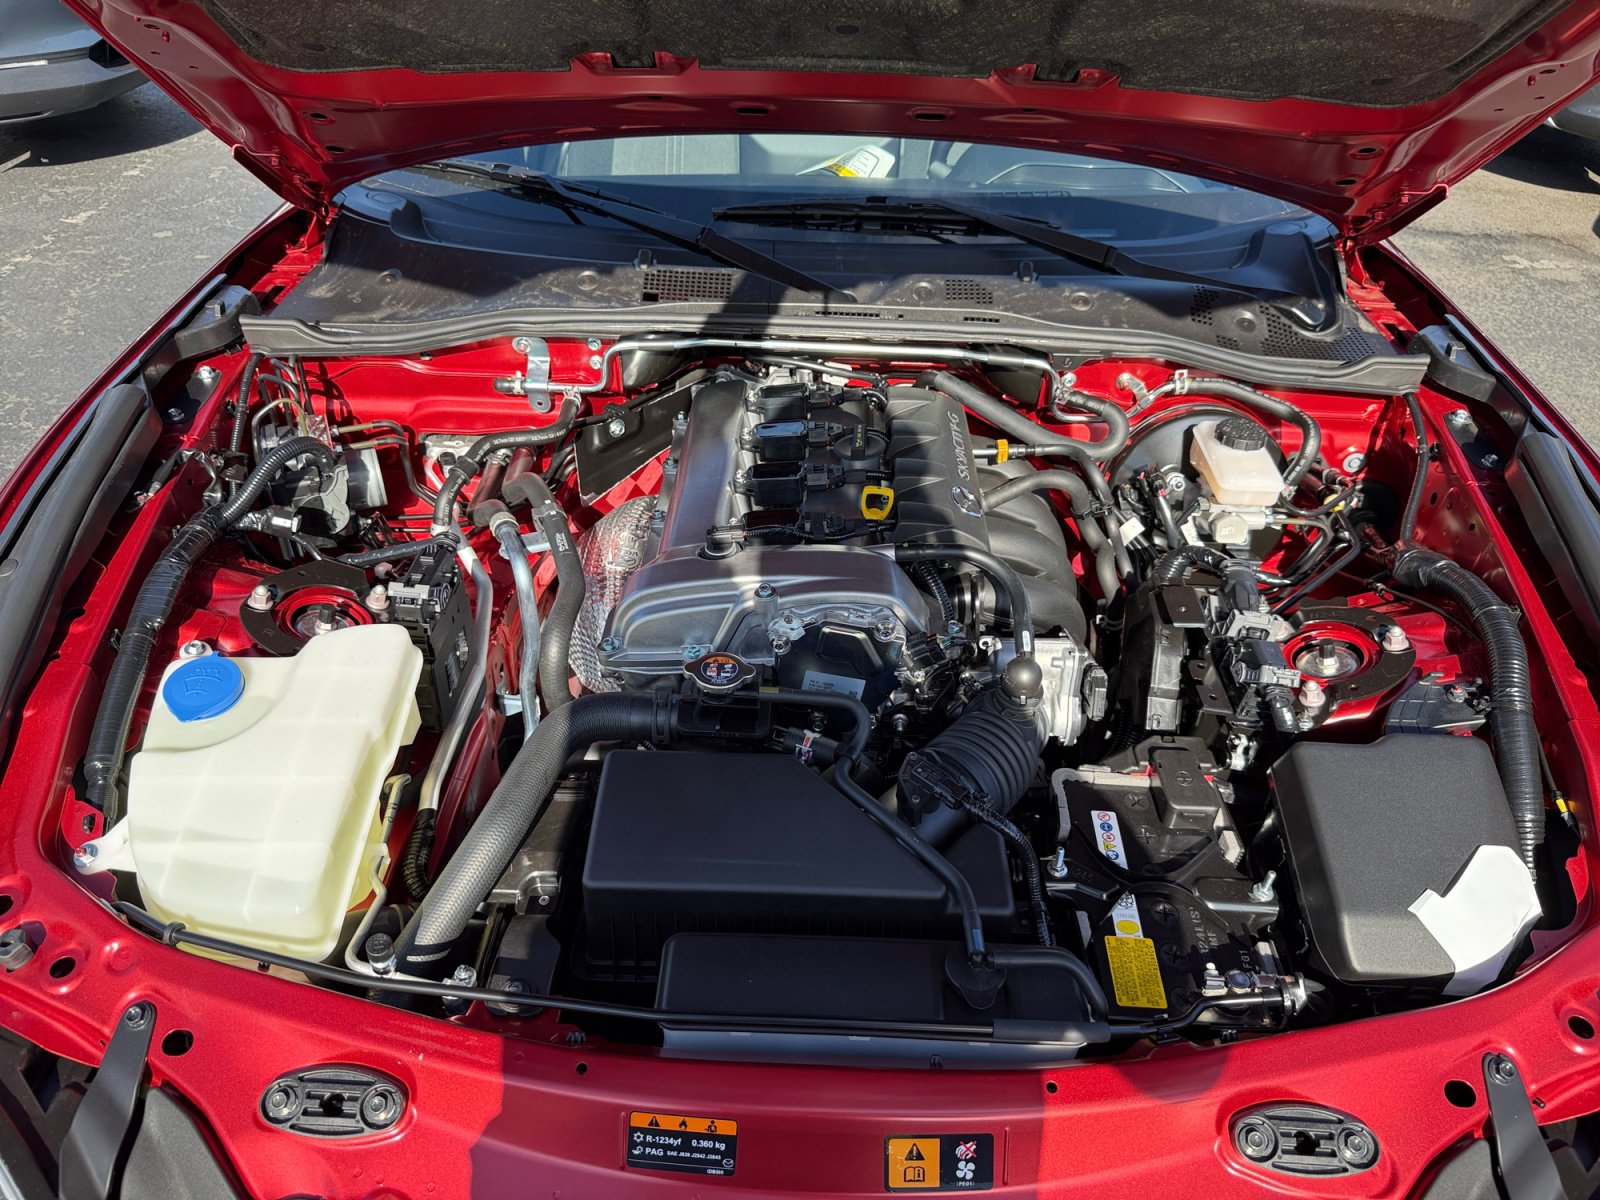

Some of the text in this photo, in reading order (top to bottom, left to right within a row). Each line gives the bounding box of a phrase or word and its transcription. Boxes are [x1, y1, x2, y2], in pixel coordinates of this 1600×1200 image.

[947, 410, 970, 481] SKYACTIV-G
[645, 1148, 664, 1156] PAG
[646, 1134, 726, 1152] R-1234yf 0.360 kg
